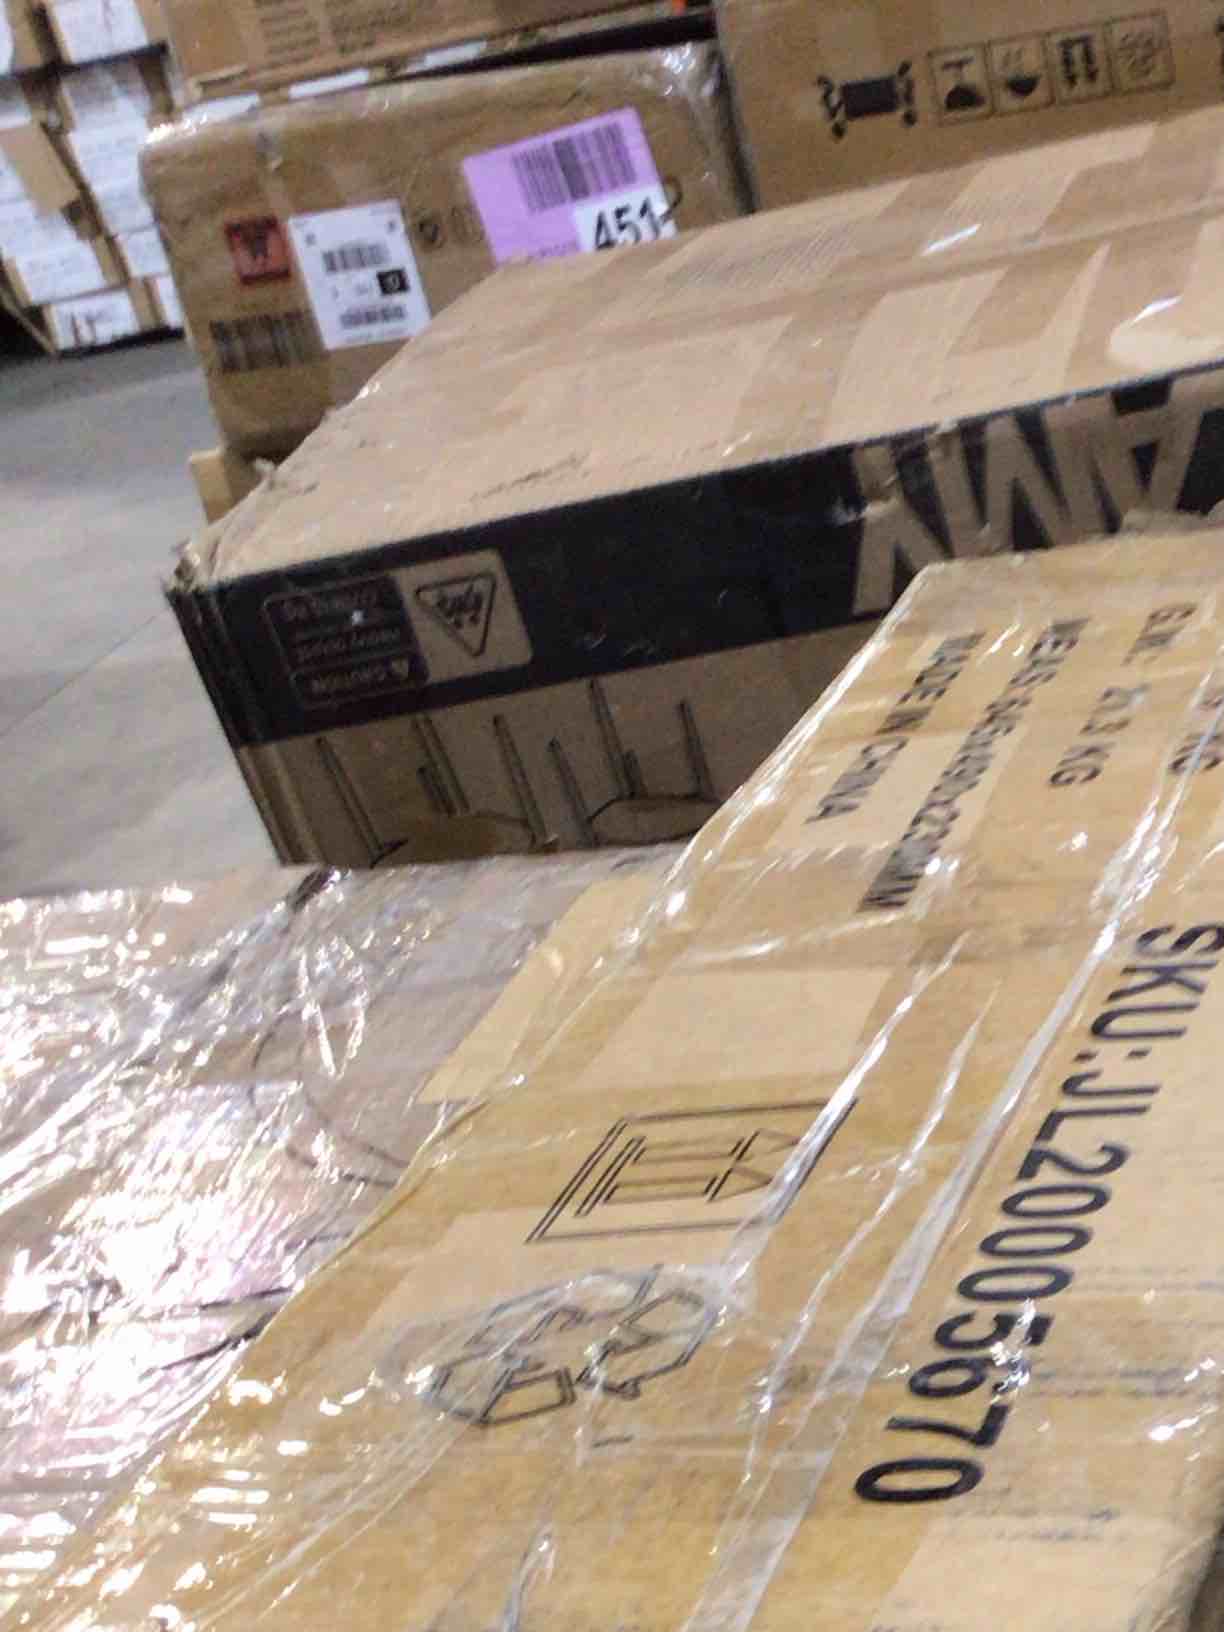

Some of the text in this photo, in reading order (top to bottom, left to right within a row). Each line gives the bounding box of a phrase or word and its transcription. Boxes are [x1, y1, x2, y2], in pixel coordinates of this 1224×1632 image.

[899, 631, 986, 704] MADE
[876, 705, 934, 734] IN
[805, 736, 908, 824] CHINA
[1048, 742, 1115, 787] KG
